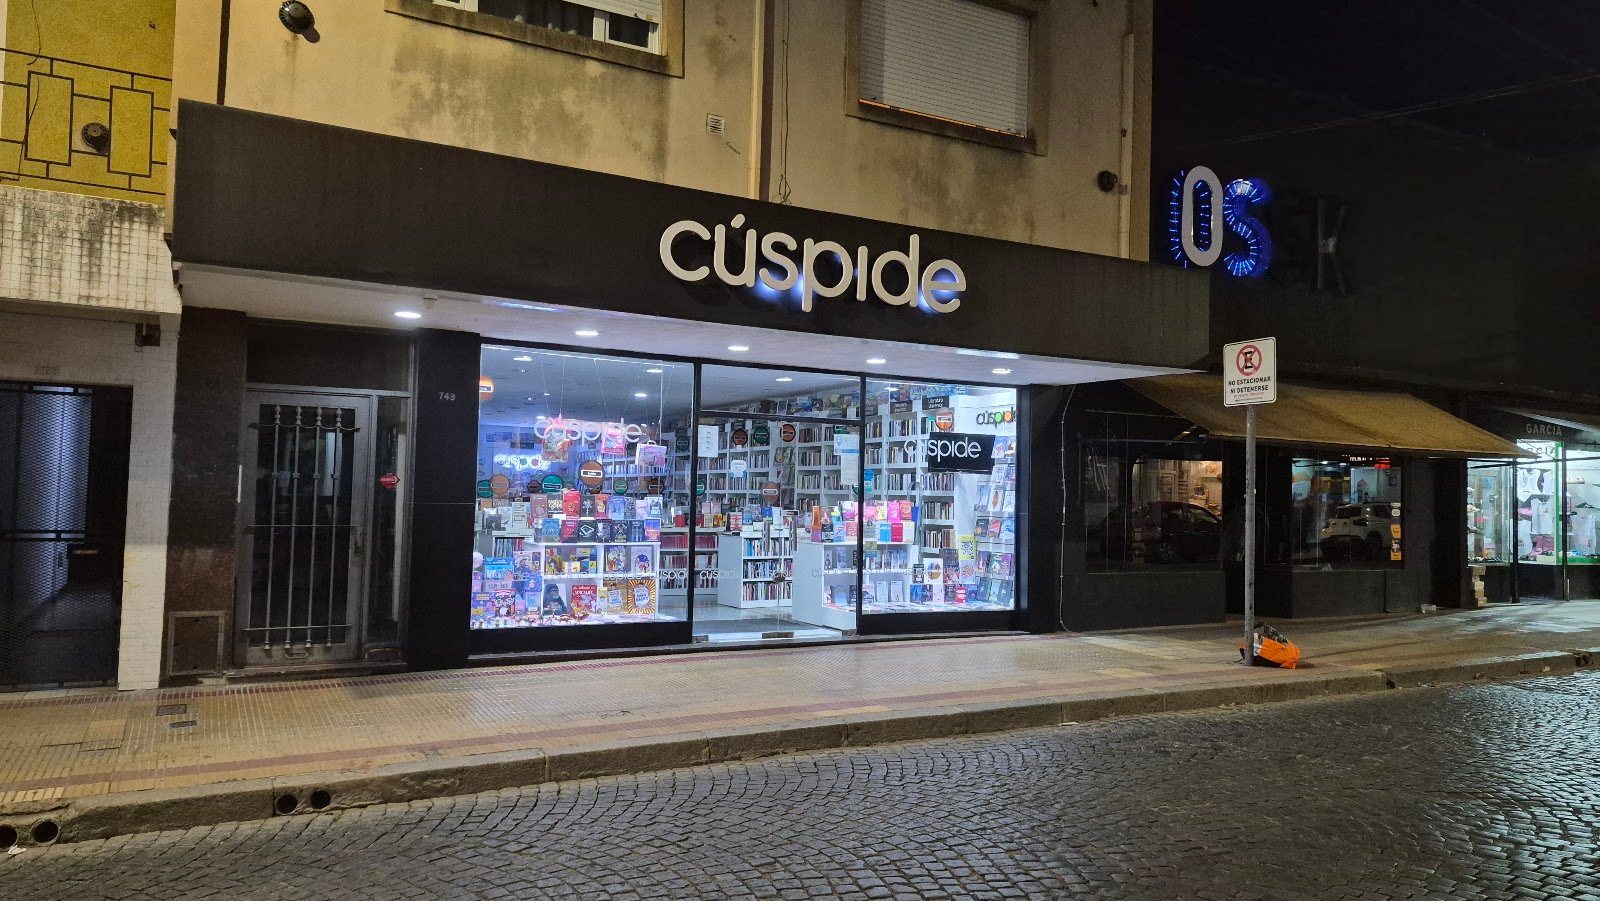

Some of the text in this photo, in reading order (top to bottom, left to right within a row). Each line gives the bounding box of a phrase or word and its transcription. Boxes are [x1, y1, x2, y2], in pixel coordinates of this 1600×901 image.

[659, 213, 967, 314] cúspide
[1237, 376, 1271, 385] ESTACIONAR
[1237, 385, 1269, 393] DETENERSE
[1525, 422, 1563, 436] GARCIA
